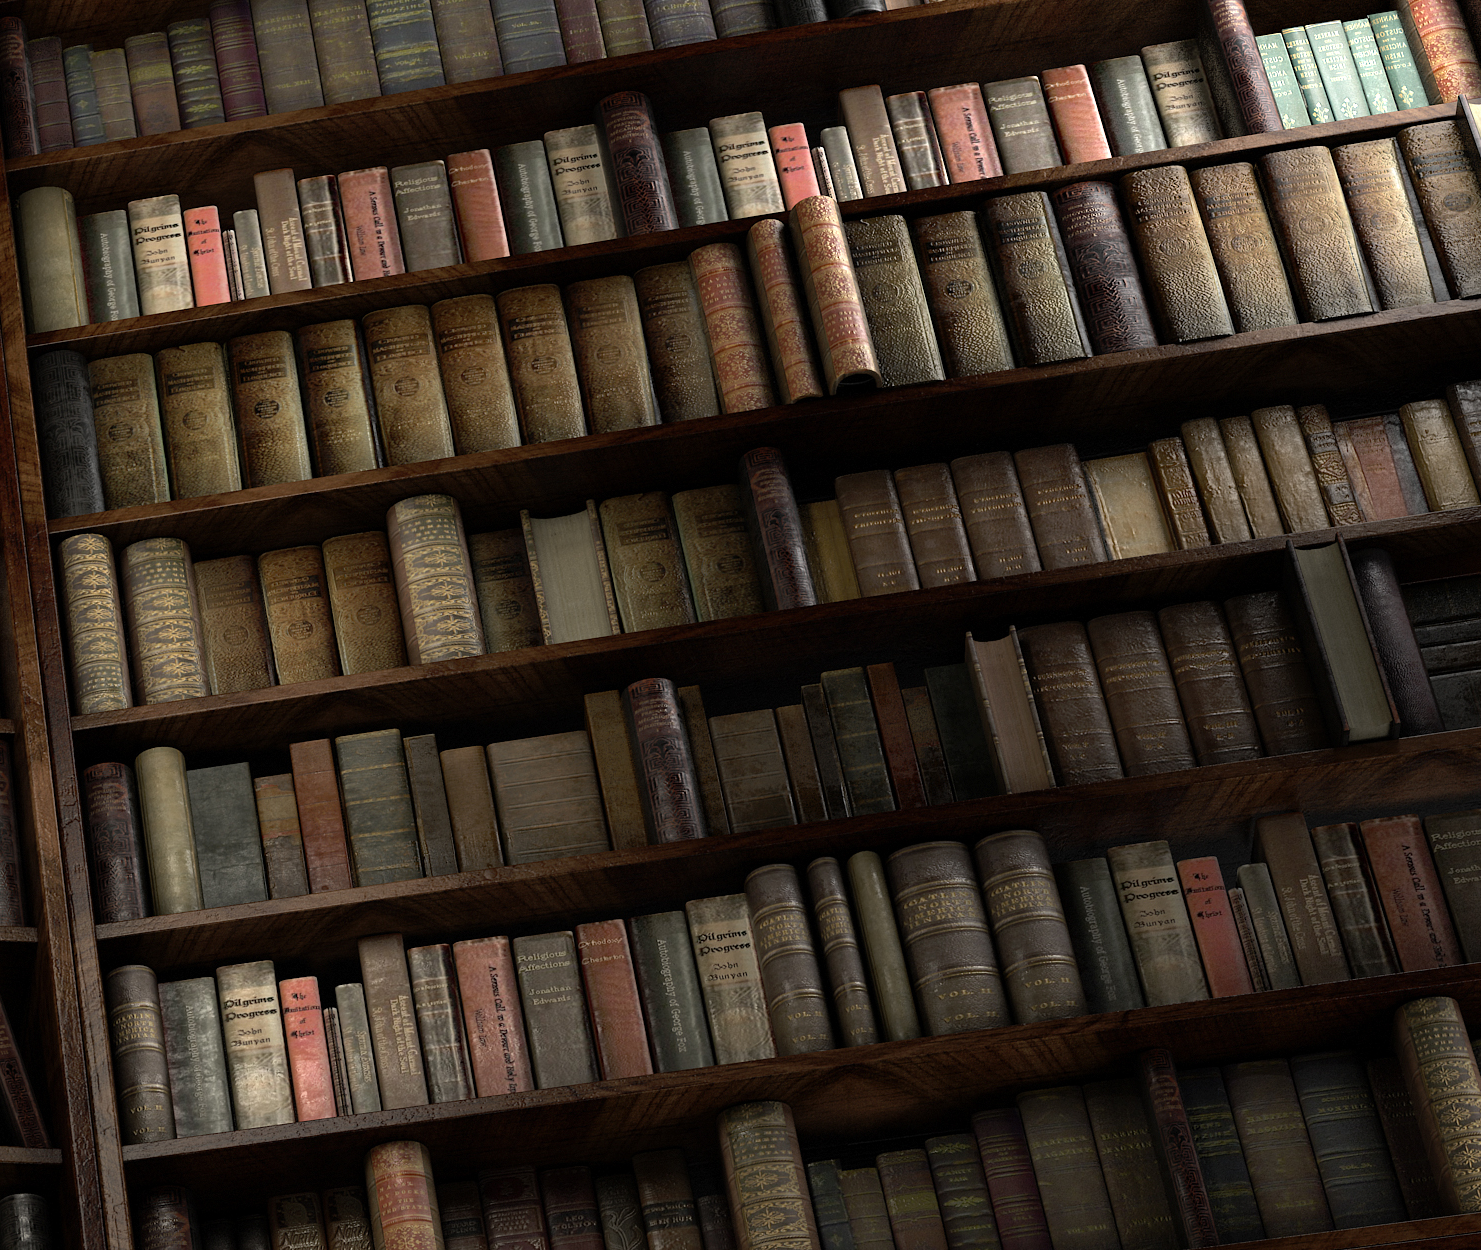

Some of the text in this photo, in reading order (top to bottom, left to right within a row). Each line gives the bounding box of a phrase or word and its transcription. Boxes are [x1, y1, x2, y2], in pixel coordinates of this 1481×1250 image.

[394, 175, 438, 189] Religious
[394, 183, 441, 196] Affections
[403, 203, 442, 214] Jonathan
[407, 211, 441, 221] Edwards
[134, 222, 179, 236] Pilgrims
[136, 232, 182, 245] Progress
[1121, 877, 1174, 891] Pilgrims
[1124, 889, 1179, 903] Progress
[517, 949, 567, 964] Religious
[518, 960, 571, 974] Affections
[528, 985, 572, 996] Jonathan
[224, 996, 275, 1010] Pilgrims
[533, 995, 571, 1006] Edwards
[225, 1008, 277, 1022] Progress
